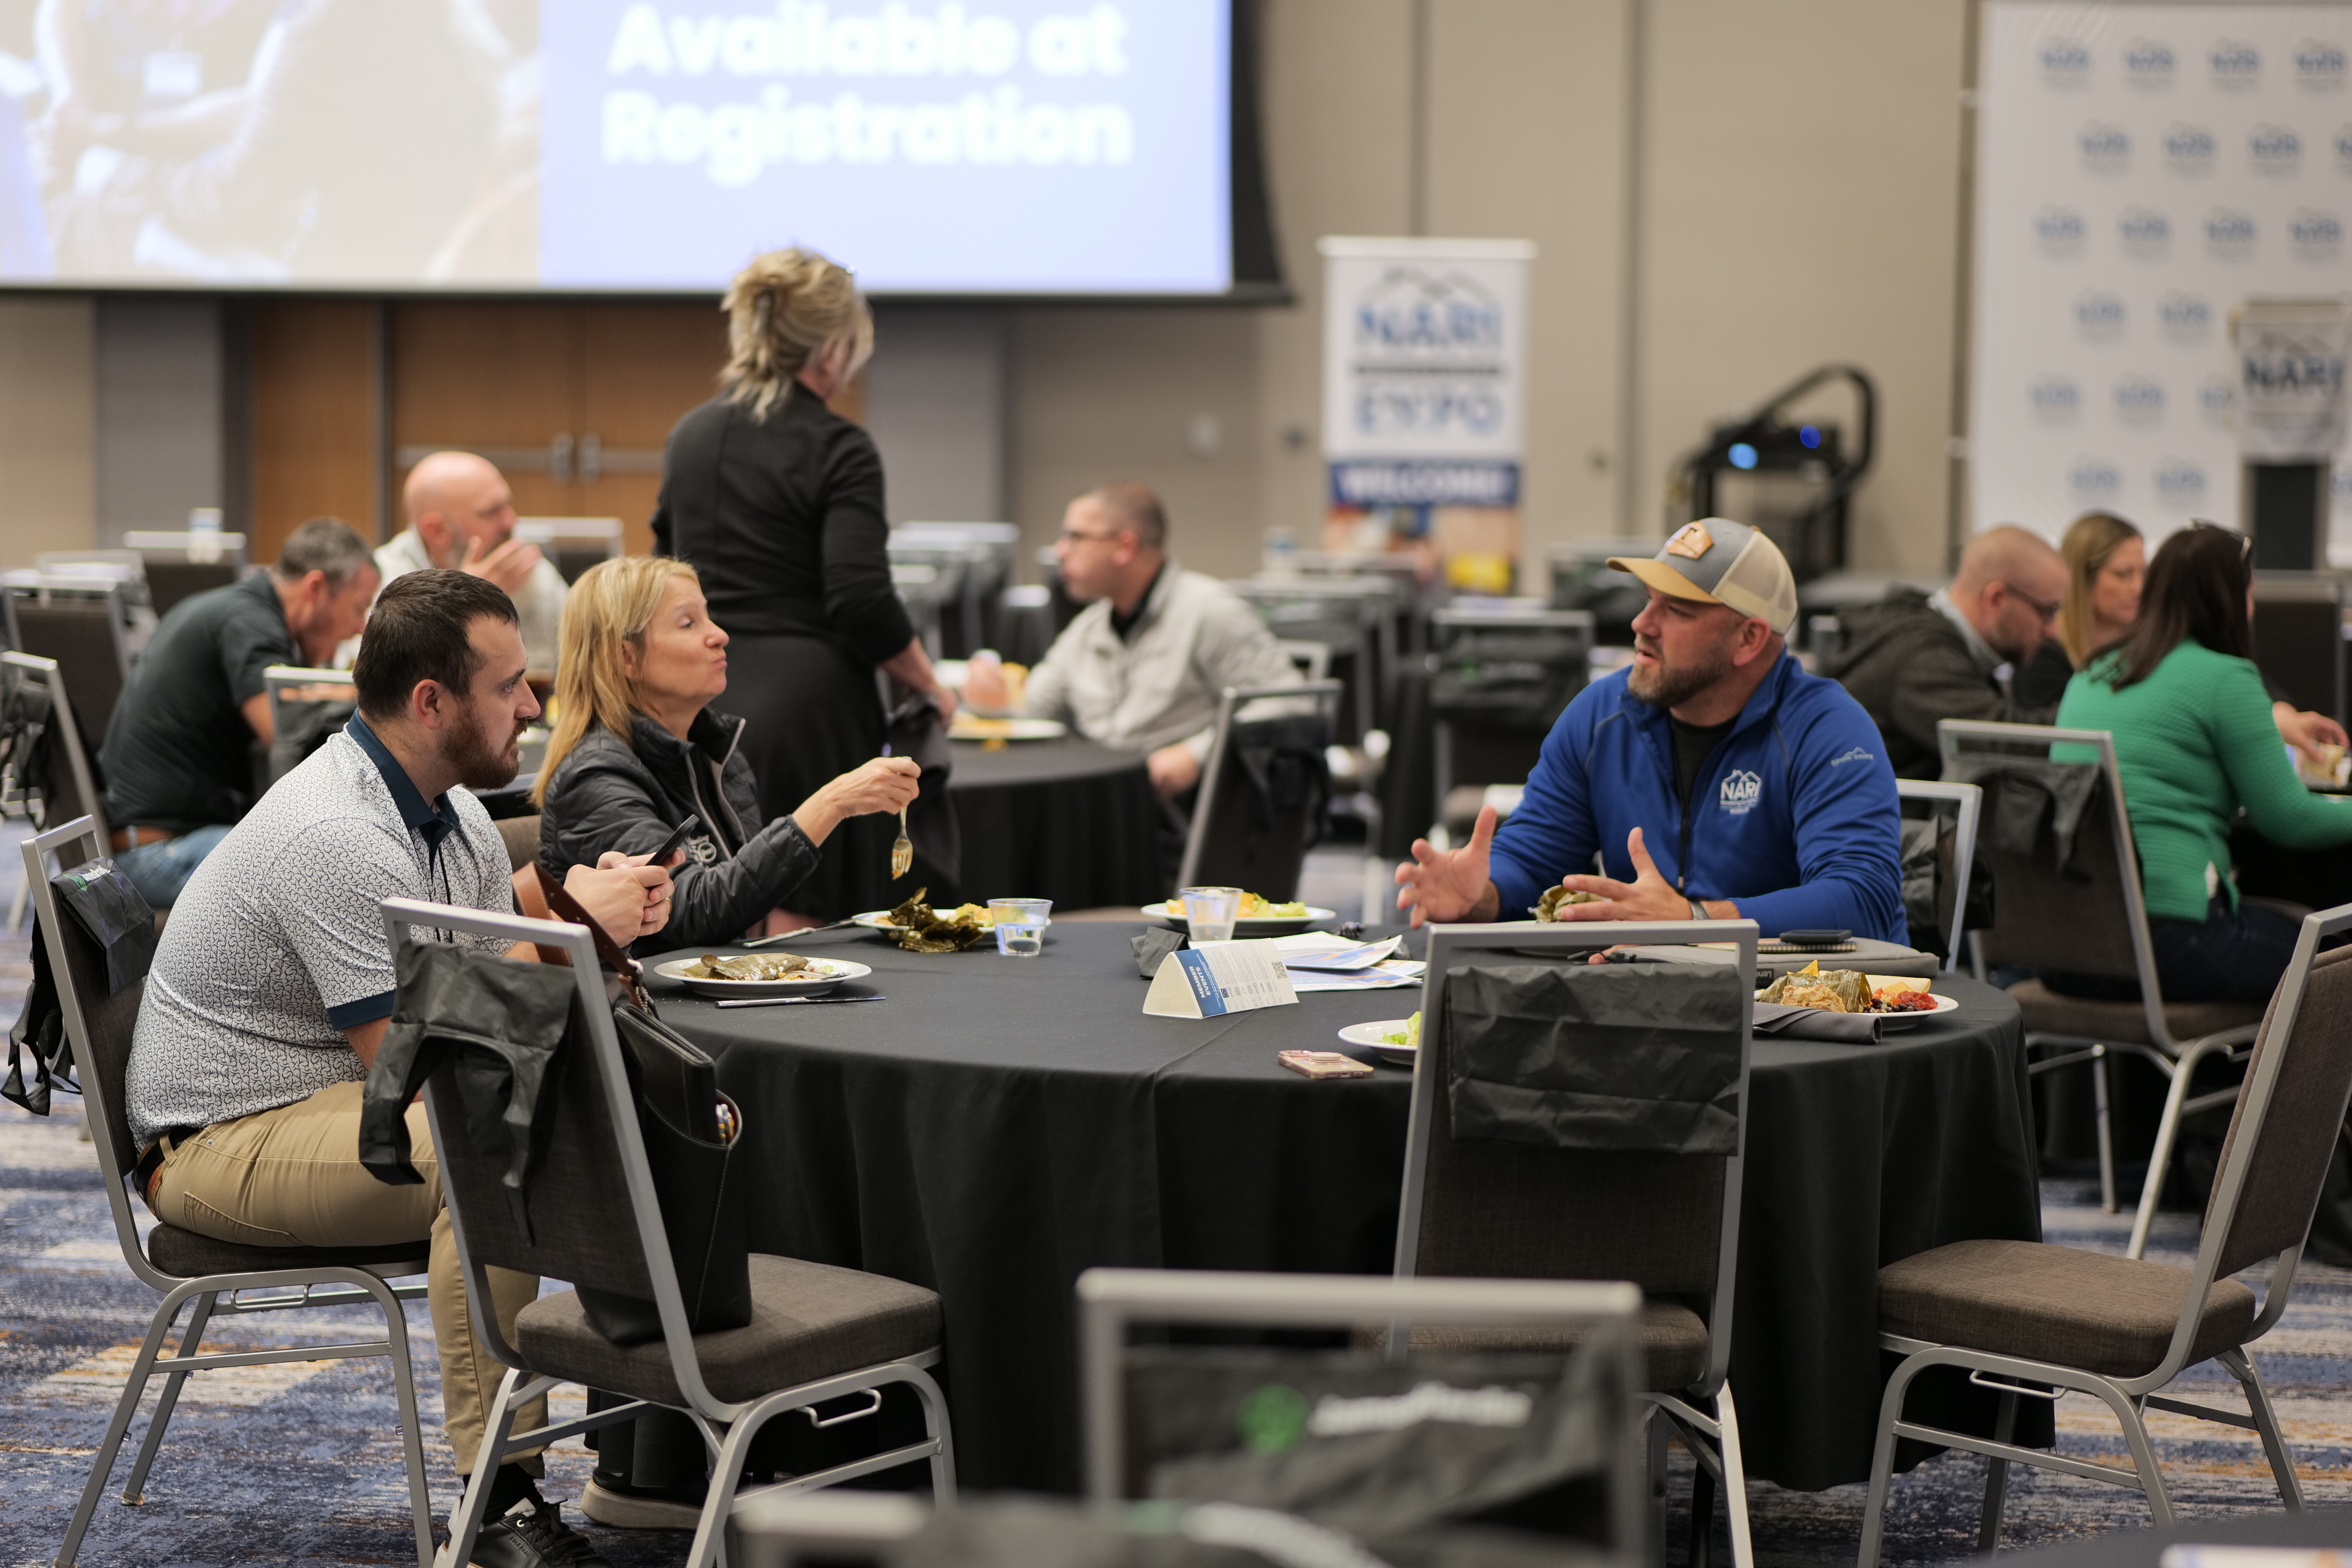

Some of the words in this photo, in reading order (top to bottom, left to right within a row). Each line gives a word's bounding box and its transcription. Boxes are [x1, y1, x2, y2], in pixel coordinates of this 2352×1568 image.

[606, 0, 1019, 75] Available
[1027, 2, 1130, 75] at
[602, 85, 1134, 187] Registration
[1720, 781, 1761, 800] NARI
[1189, 966, 1206, 998] MEMBER
[1196, 966, 1211, 996] EVENTS
